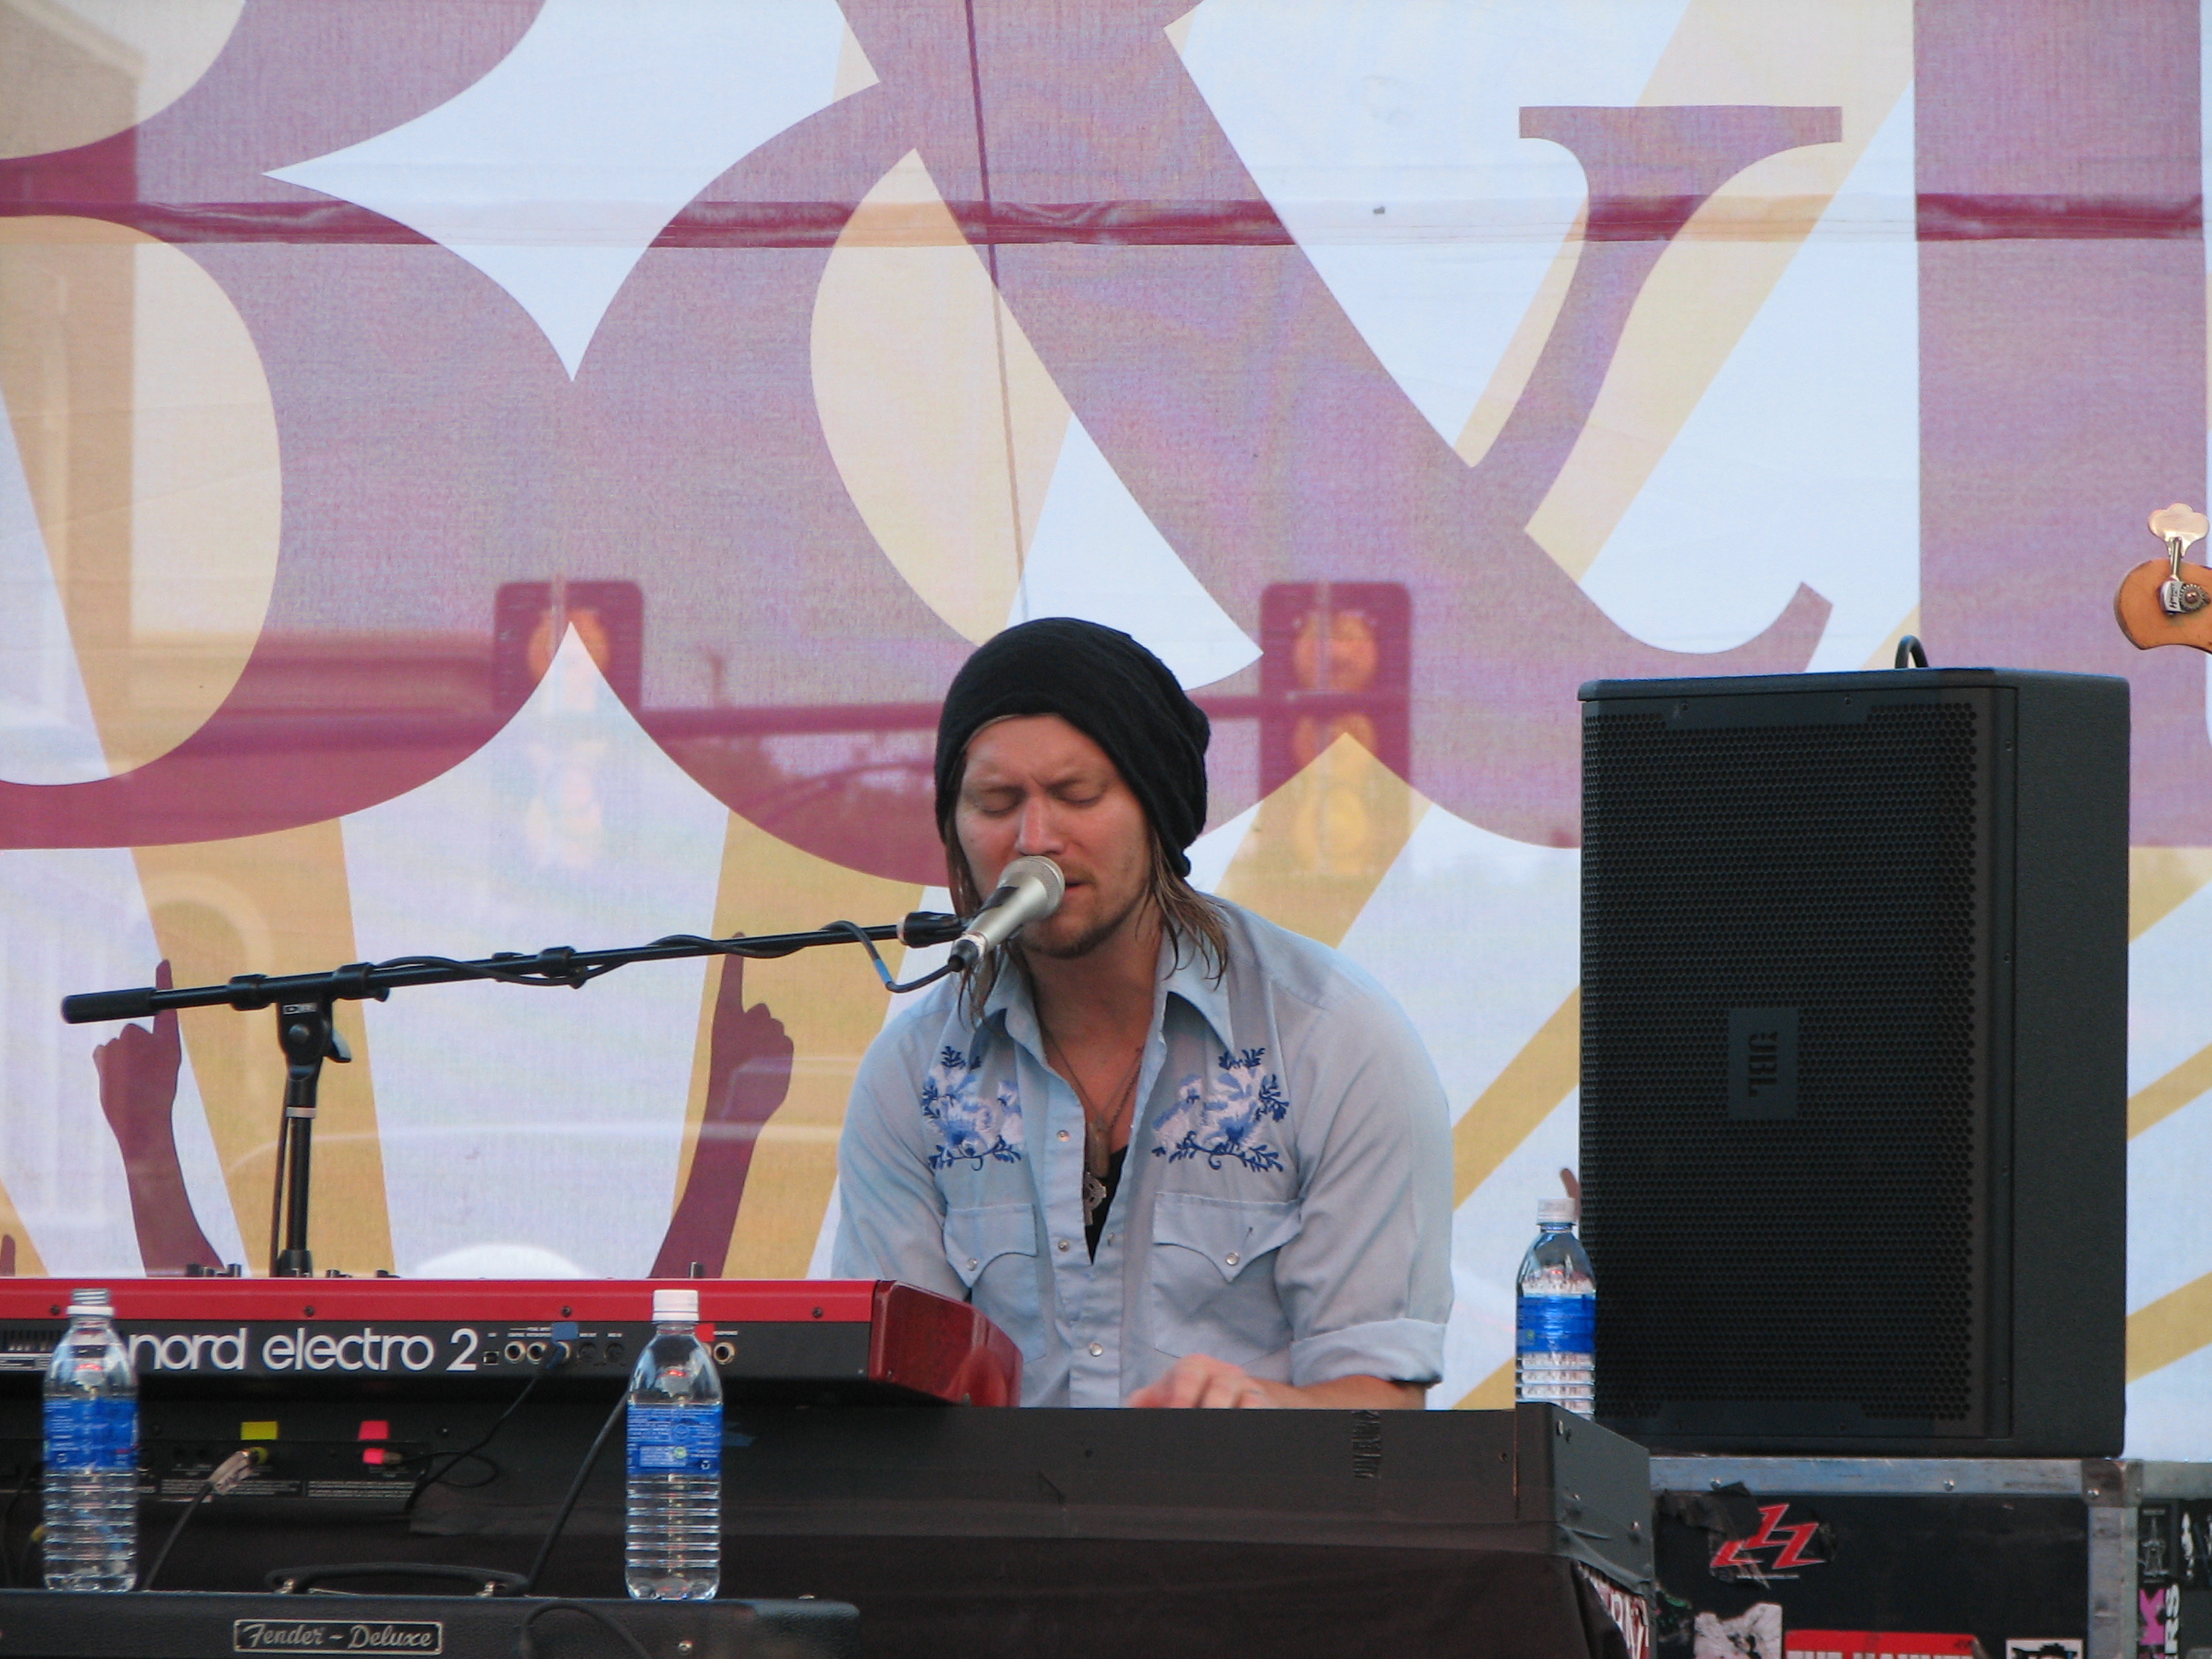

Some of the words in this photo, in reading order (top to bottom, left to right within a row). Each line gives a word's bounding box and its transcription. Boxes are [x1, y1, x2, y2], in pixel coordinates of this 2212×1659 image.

[1749, 1032, 1778, 1097] JBL
[129, 1327, 247, 1371] nord
[262, 1327, 434, 1371] electro
[445, 1327, 478, 1371] 2
[243, 1624, 324, 1648] Fender
[347, 1624, 433, 1649] Deluxe
